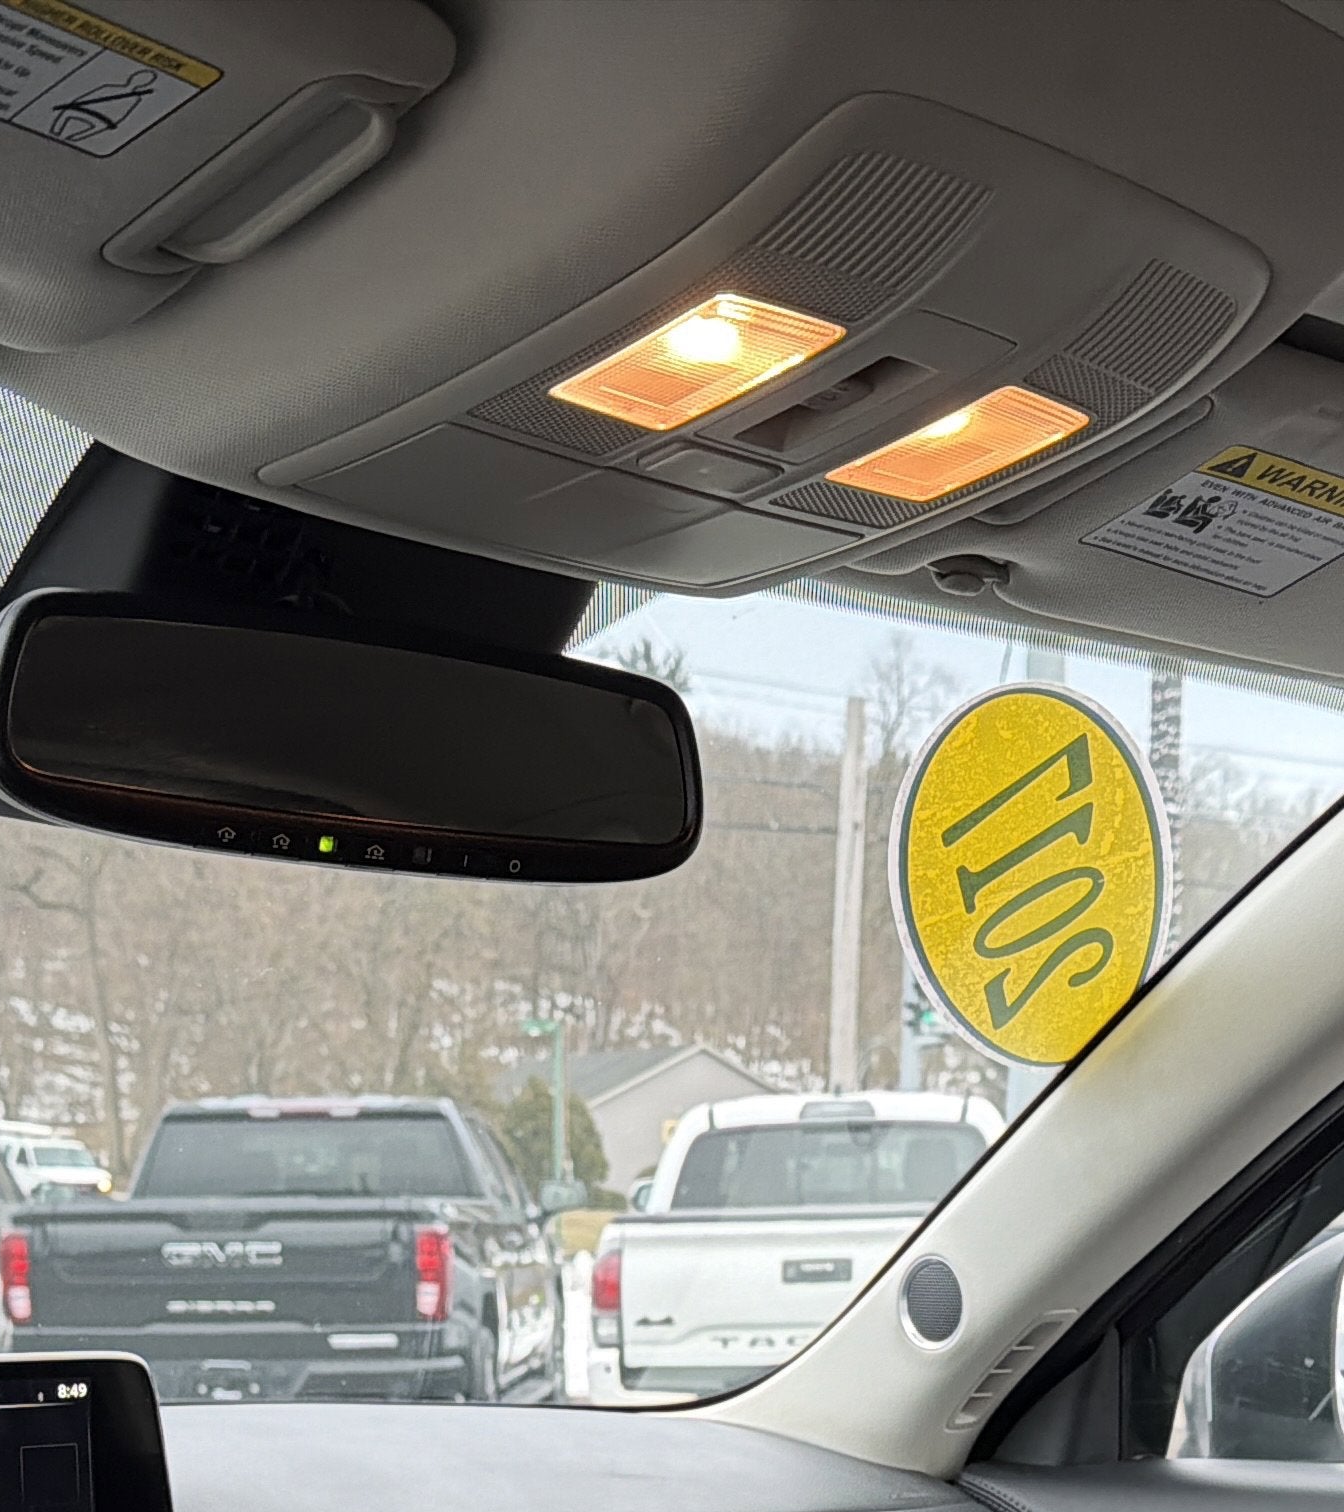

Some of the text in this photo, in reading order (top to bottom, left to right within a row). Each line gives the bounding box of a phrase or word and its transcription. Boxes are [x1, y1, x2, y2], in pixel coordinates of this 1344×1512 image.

[1201, 479, 1228, 493] EVEN
[1231, 488, 1256, 502] WITH
[1259, 498, 1313, 518] ADVANCED
[1314, 515, 1333, 525] AIR
[161, 1241, 284, 1267] GMC
[710, 1335, 811, 1350] TAC
[57, 1382, 88, 1399] 8:49
